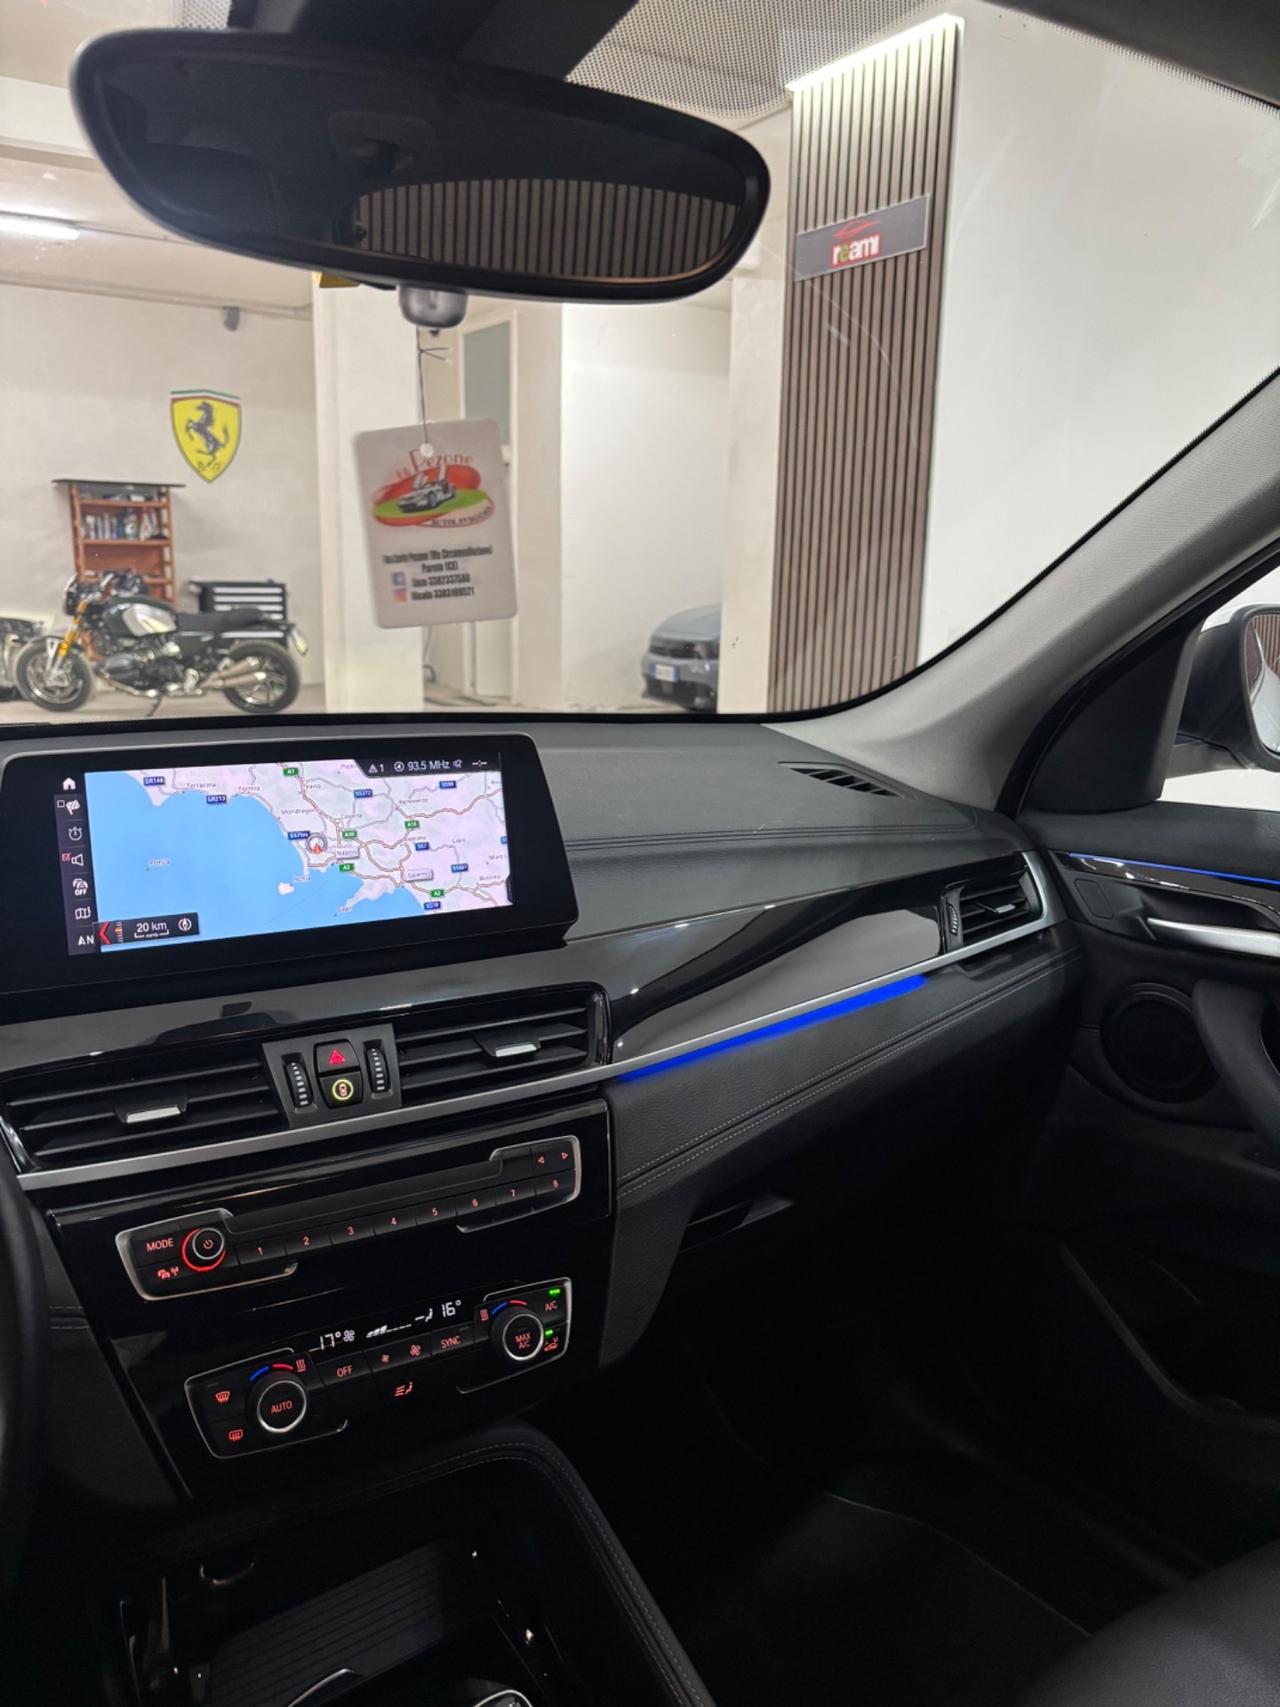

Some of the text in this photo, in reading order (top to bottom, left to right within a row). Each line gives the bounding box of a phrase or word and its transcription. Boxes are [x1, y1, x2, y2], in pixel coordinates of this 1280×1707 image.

[407, 760, 451, 771] 93.5 MHz
[136, 920, 168, 932] 20 km
[471, 1198, 478, 1207] 6
[431, 1207, 439, 1217] 5
[347, 1226, 354, 1236] 3
[146, 1237, 174, 1252] MODE
[303, 1236, 311, 1246] 2
[440, 1335, 461, 1350] SYNC
[514, 1331, 532, 1343] MAX
[336, 1365, 353, 1377] OFF
[270, 1400, 293, 1415] AUTO
